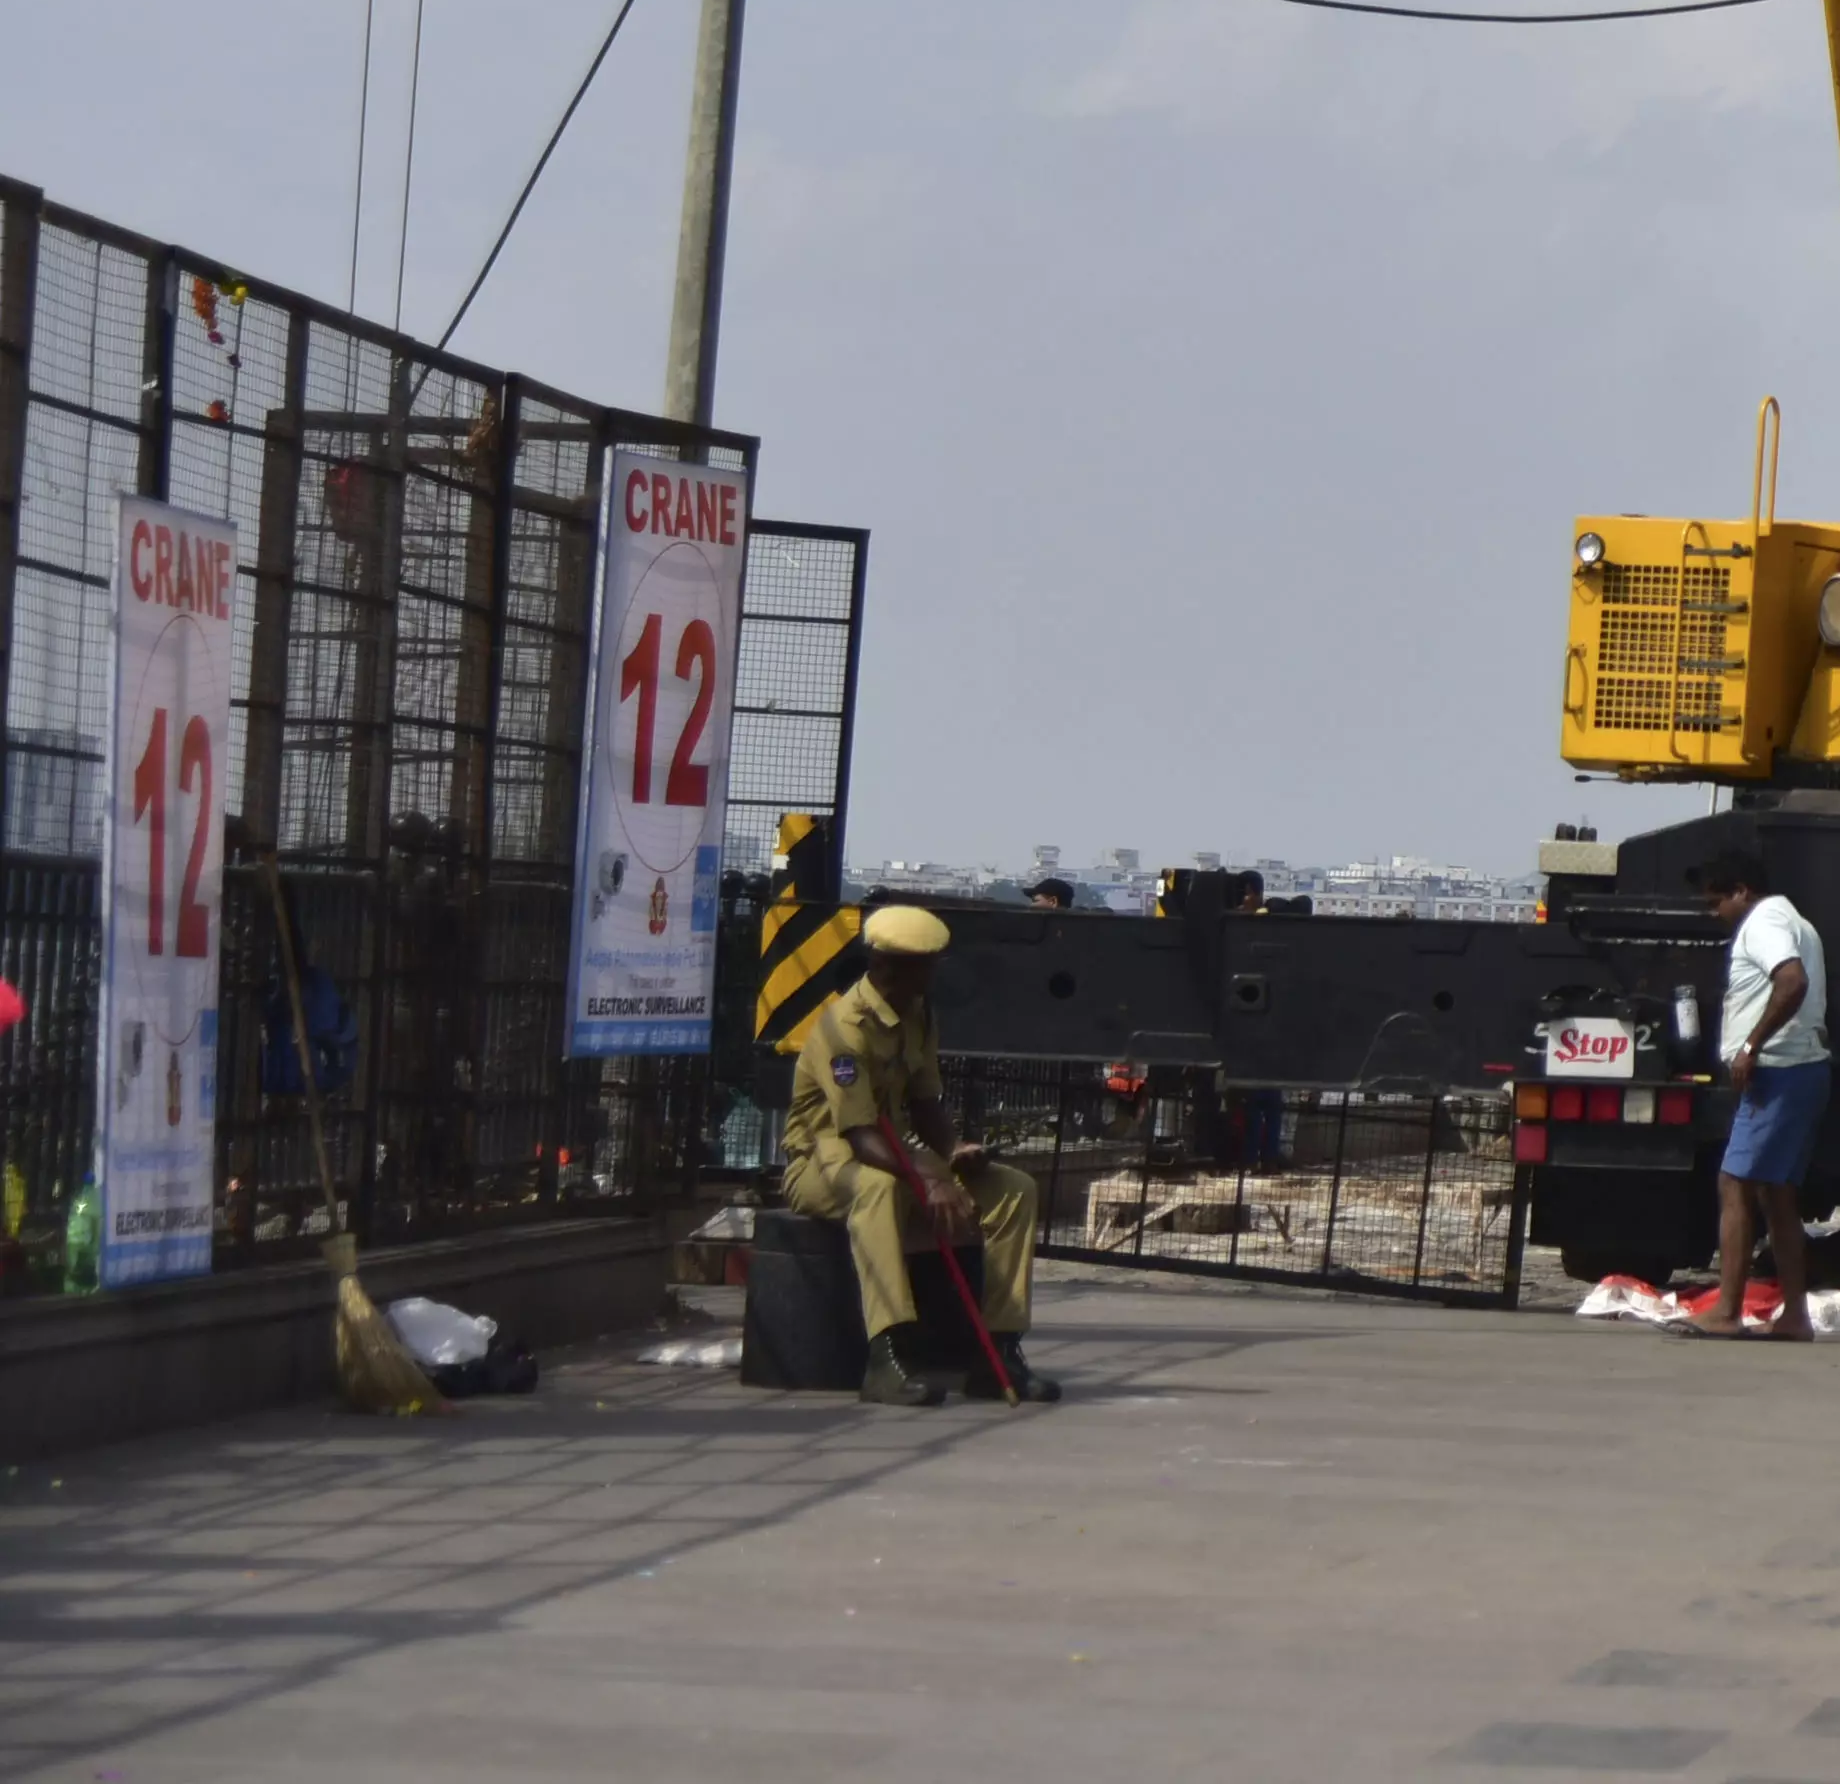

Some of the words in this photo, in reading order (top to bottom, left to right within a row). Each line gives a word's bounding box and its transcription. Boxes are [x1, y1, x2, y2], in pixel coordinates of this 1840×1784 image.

[624, 468, 738, 548] CRANE
[129, 517, 232, 622] CRANE
[619, 612, 718, 808] 12
[134, 707, 212, 958] 12
[588, 997, 643, 1016] ELECTRONIC
[644, 995, 706, 1015] SURVEILLANCE
[1554, 1028, 1629, 1064] Stop
